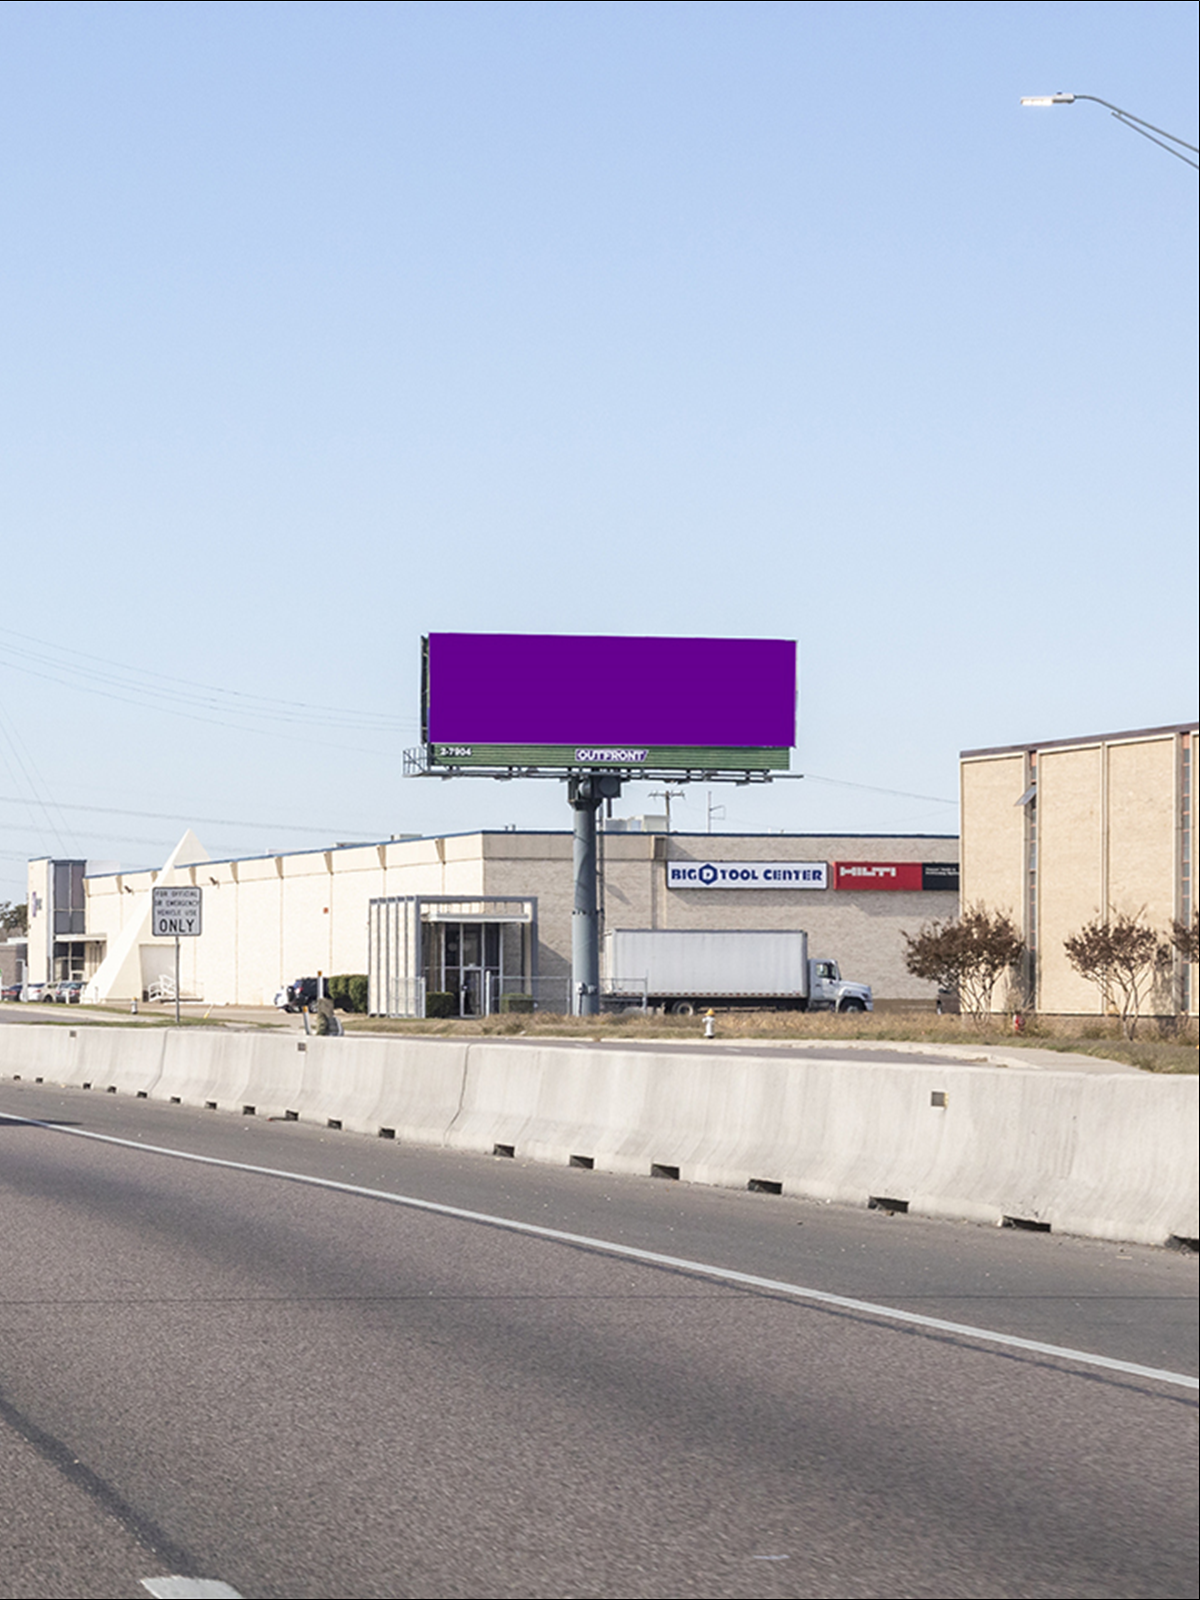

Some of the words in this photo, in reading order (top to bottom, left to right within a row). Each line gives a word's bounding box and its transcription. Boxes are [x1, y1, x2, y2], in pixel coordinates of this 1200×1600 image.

[577, 748, 646, 761] OUTFRONT
[671, 869, 698, 880] BIG
[720, 869, 758, 881] TOOL
[763, 869, 823, 881] CENTER
[840, 866, 897, 877] HILTI
[159, 918, 195, 932] ONLY
